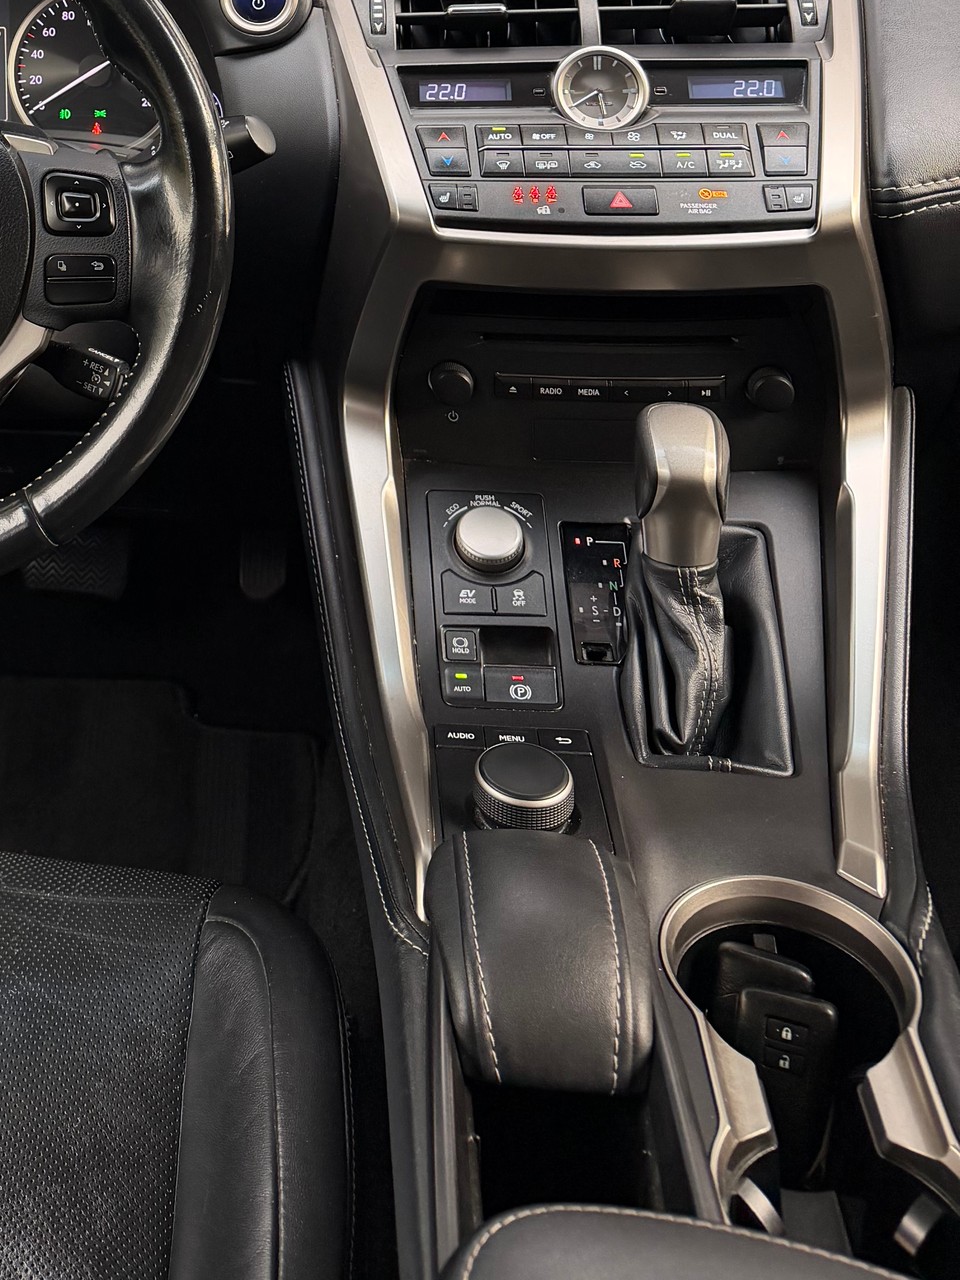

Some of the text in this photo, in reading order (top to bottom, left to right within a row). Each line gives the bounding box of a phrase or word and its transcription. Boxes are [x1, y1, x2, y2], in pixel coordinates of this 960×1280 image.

[61, 11, 75, 20] 80
[42, 27, 56, 37] 60
[30, 49, 44, 59] 40
[29, 75, 43, 84] 20
[426, 84, 467, 100] 22.0
[733, 80, 775, 97] 22.0
[712, 131, 738, 139] DUAL
[676, 161, 695, 169] A/C
[90, 361, 105, 373] RES
[83, 382, 97, 393] SET
[540, 387, 562, 395] RADIO
[578, 388, 600, 396] MEDIA
[446, 503, 460, 516] ECO
[510, 501, 533, 518] SPORT
[586, 536, 594, 547] P
[613, 558, 622, 568] R
[609, 580, 619, 591] N
[459, 589, 476, 597] EV
[591, 605, 599, 616] S
[612, 606, 622, 617] D
[447, 731, 475, 740] AUDIO
[498, 734, 526, 743] MENU
